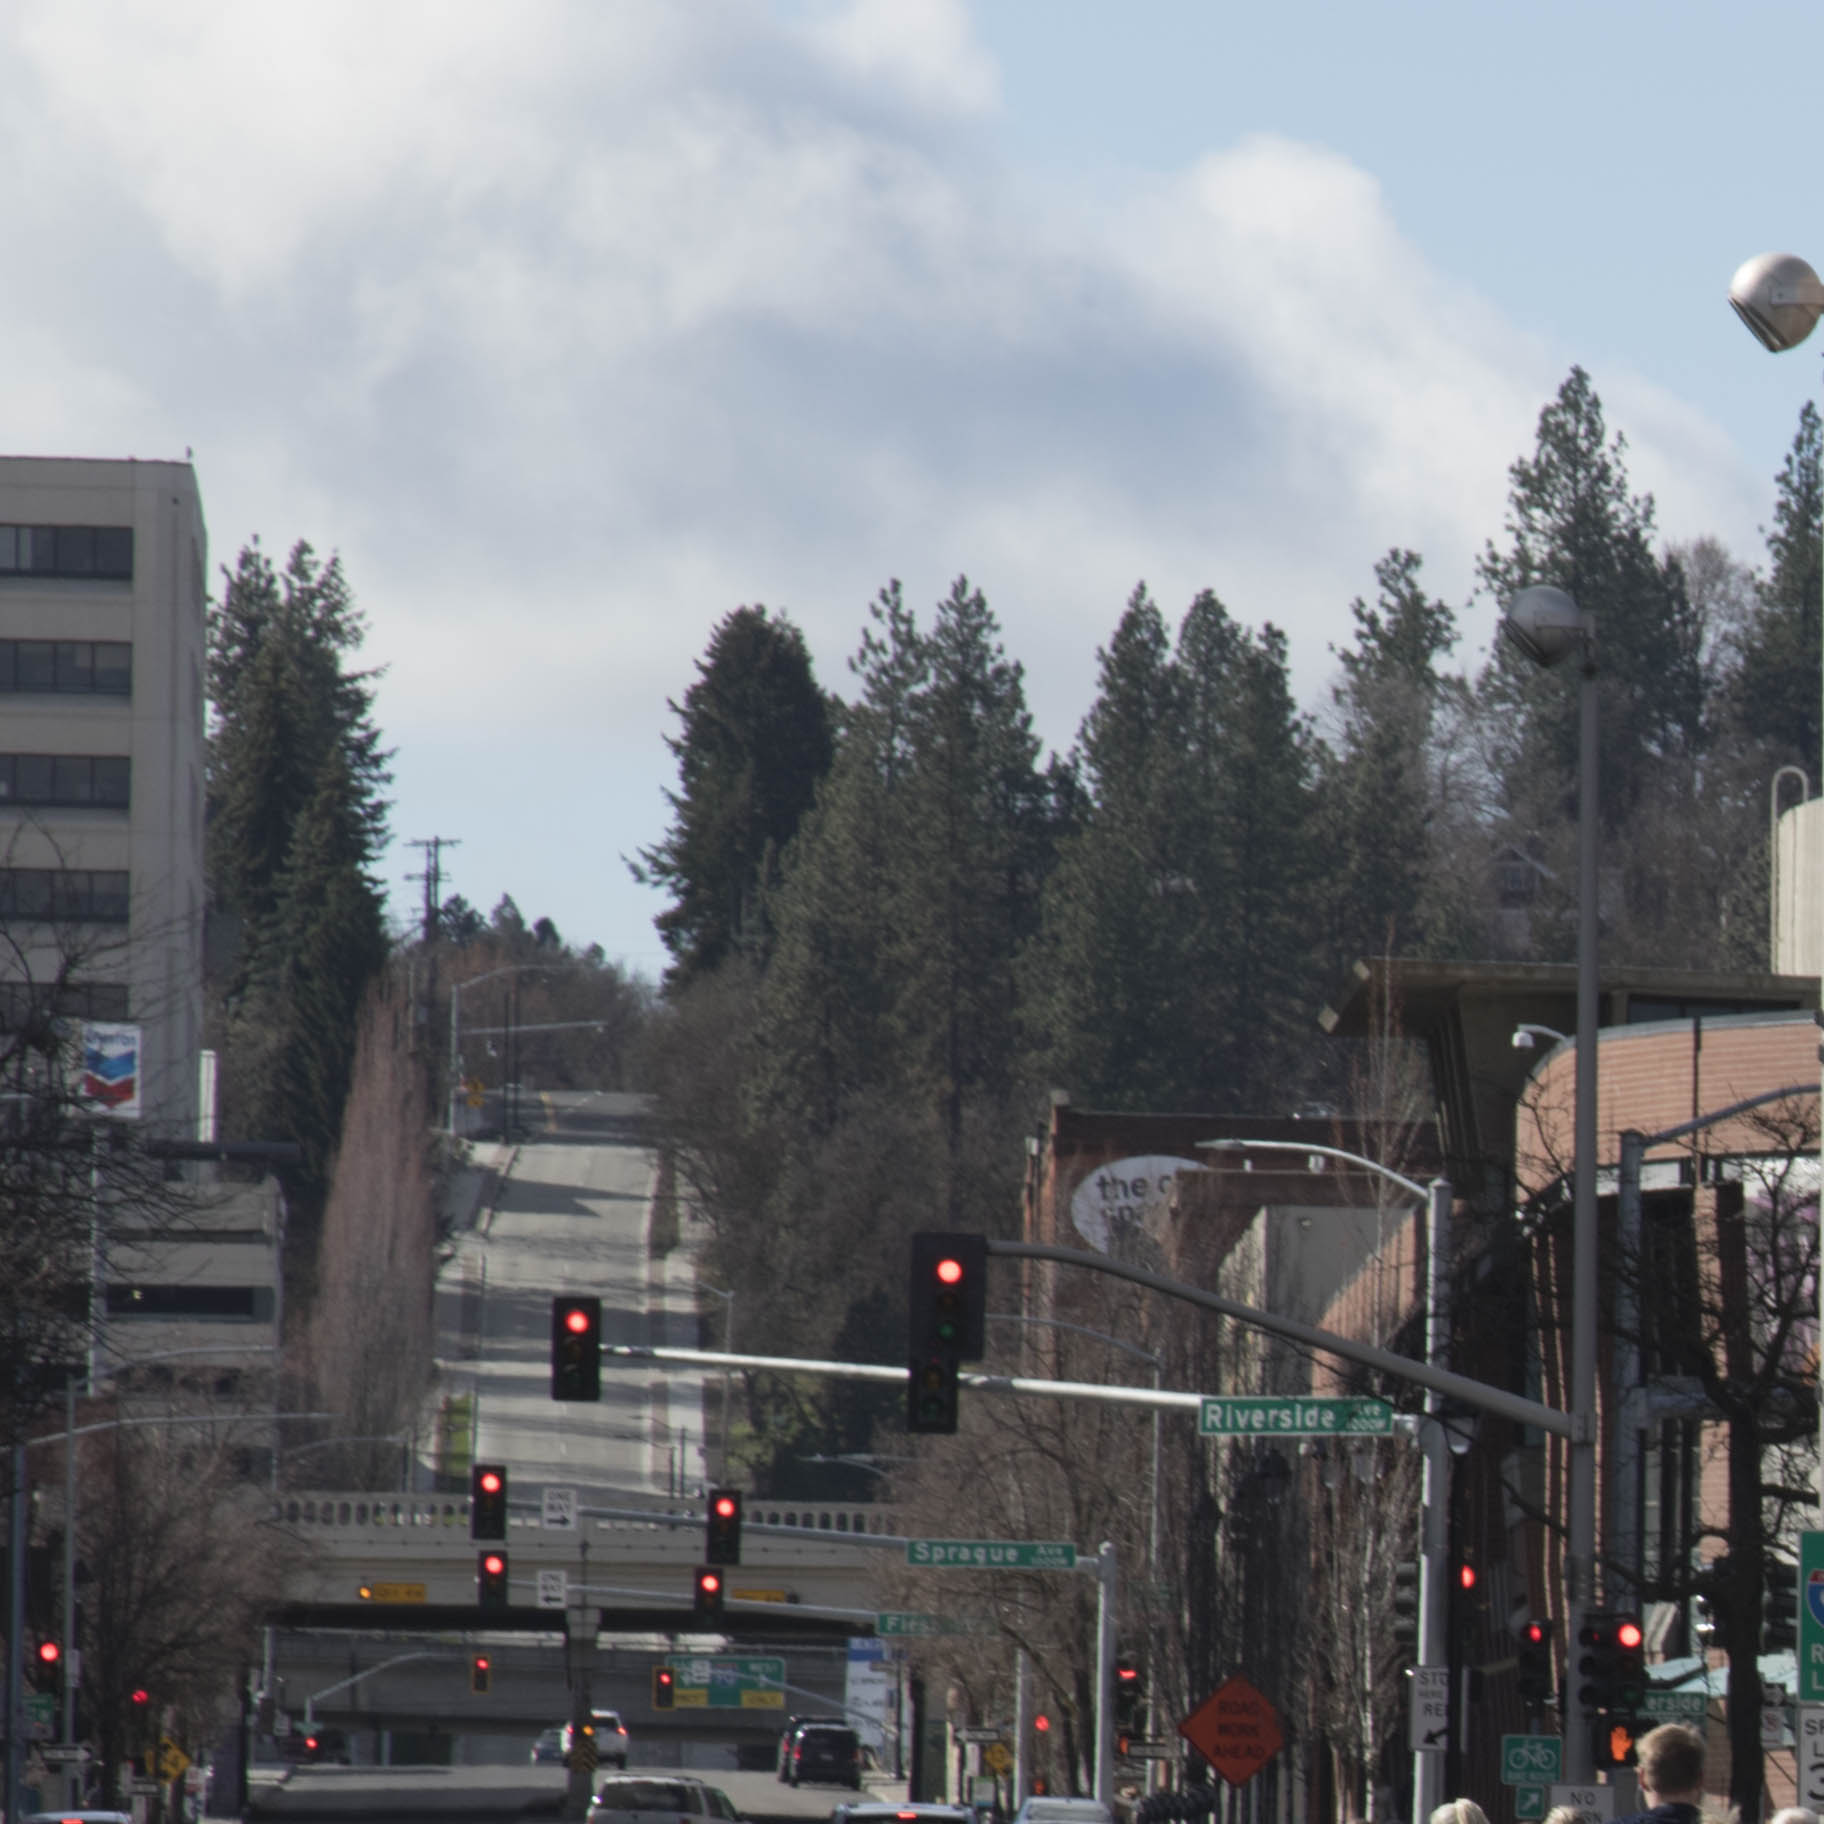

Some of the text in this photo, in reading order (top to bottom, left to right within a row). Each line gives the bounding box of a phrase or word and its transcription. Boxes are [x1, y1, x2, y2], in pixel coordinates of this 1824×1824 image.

[1096, 1175, 1148, 1199] the
[1205, 1404, 1335, 1429] Riverside
[915, 1542, 1019, 1566] Sprague
[1423, 1703, 1444, 1717] RE
[1570, 1792, 1597, 1806] NO
